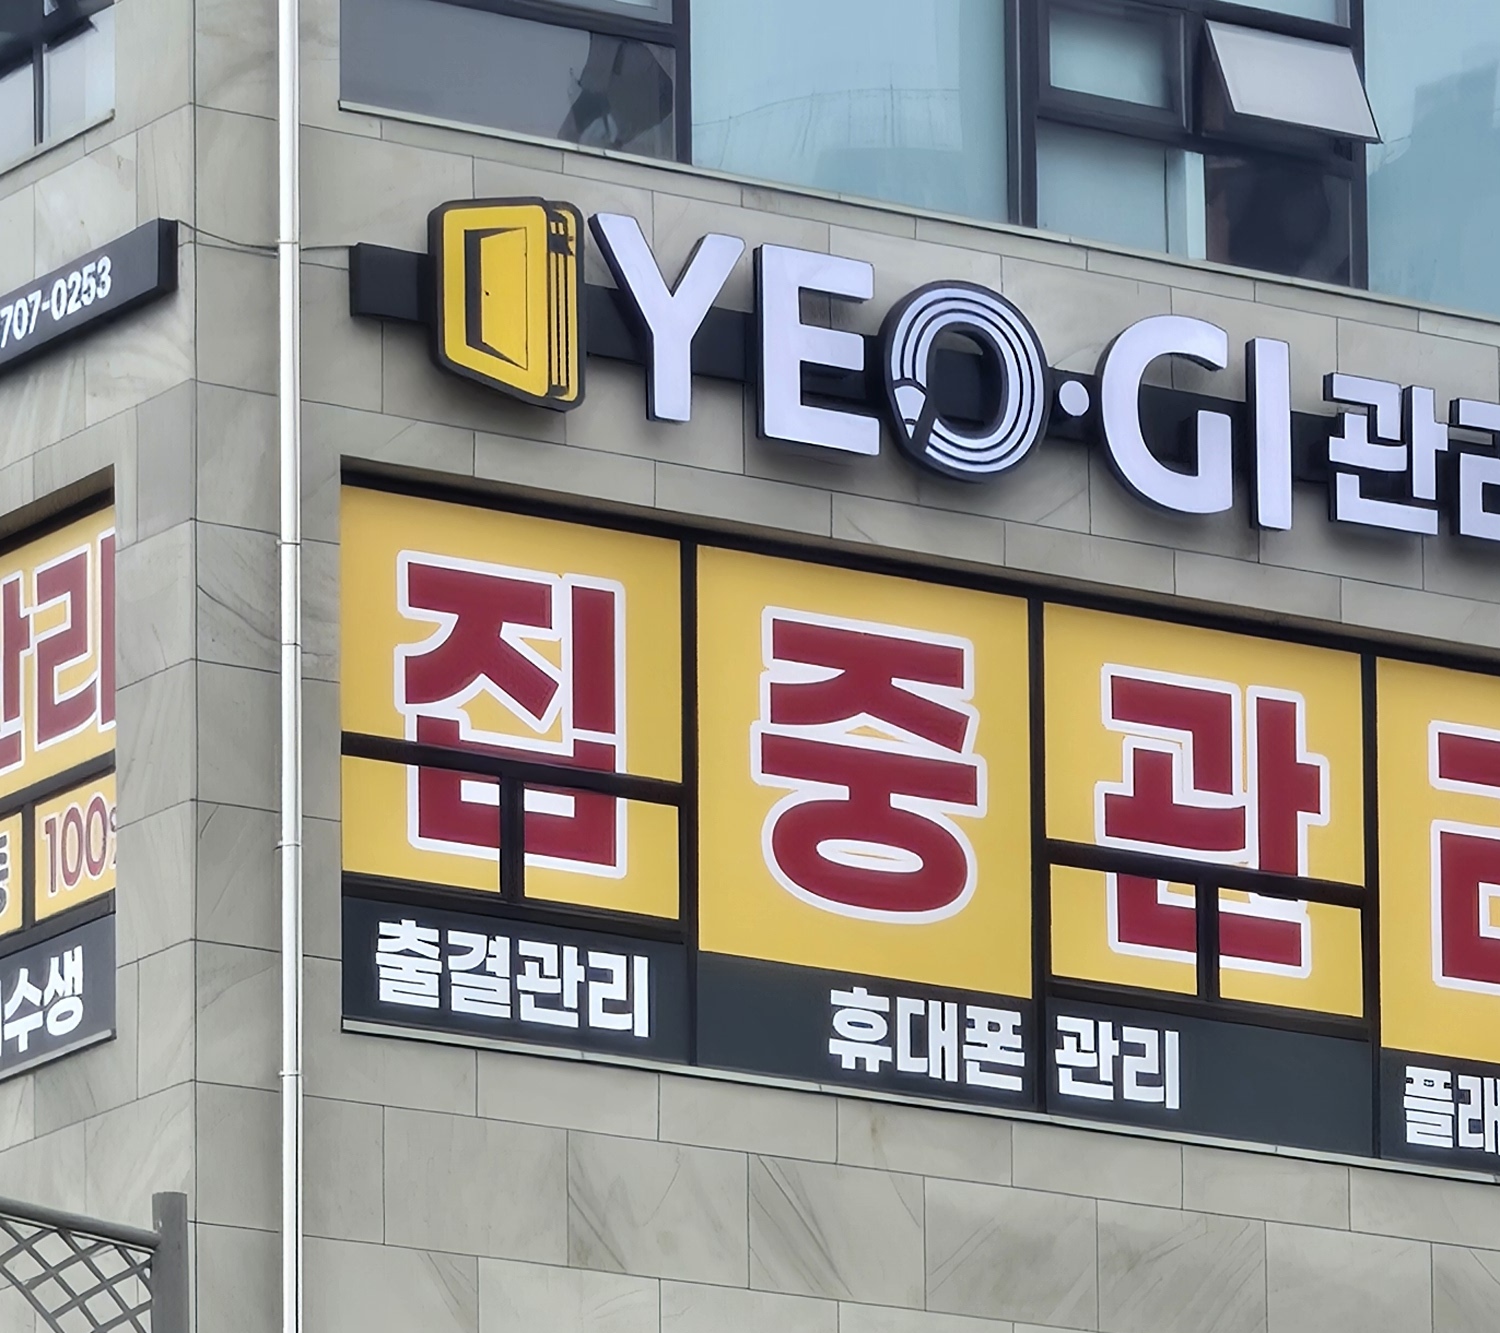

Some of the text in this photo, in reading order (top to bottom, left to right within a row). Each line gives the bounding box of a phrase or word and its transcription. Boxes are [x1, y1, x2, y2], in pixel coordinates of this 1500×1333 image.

[0, 527, 115, 774] 리
[42, 790, 115, 898] 100
[375, 918, 649, 1038] 출결관리
[828, 986, 1180, 1110] 휴대폰 관리
